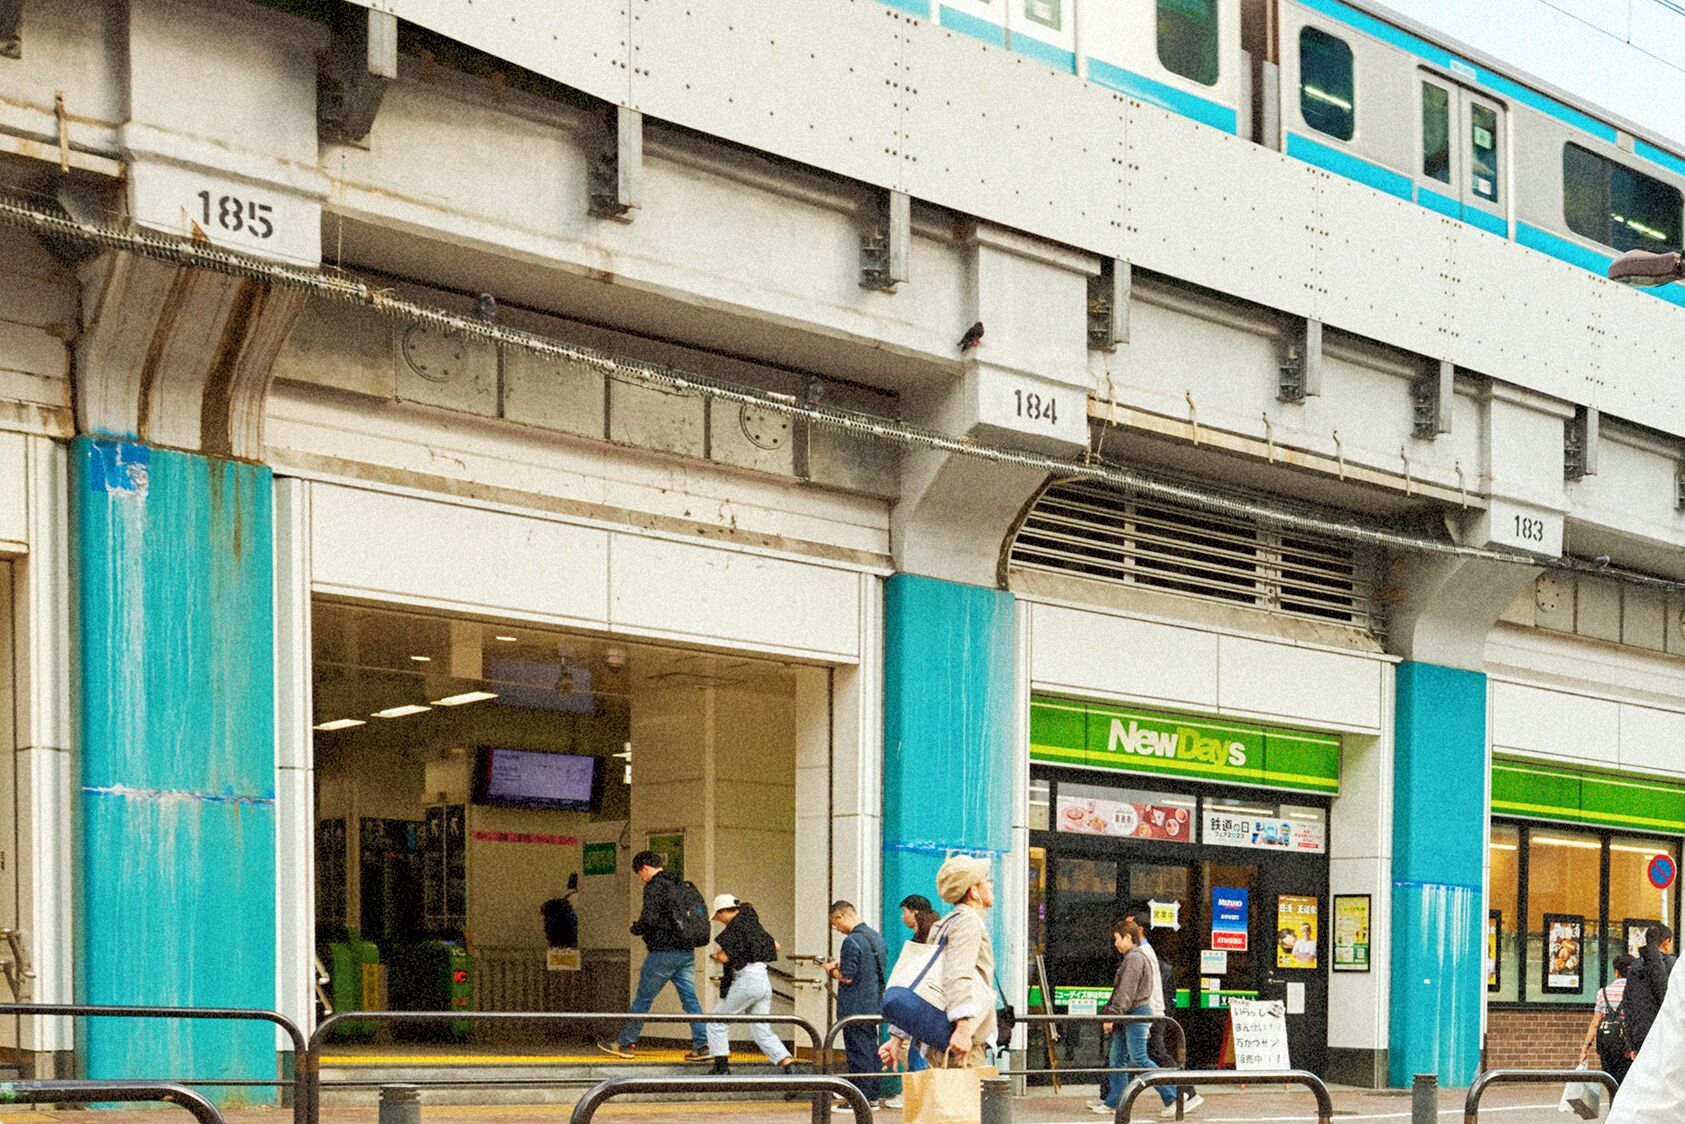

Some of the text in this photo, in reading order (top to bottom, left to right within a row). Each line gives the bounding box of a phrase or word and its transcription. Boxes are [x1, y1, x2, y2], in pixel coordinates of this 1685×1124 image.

[197, 190, 273, 239] 185
[1014, 388, 1058, 425] 184
[1514, 515, 1544, 542] 183
[1107, 718, 1247, 767] NewDays
[1210, 817, 1250, 833] 鉄道の日
[1218, 898, 1243, 908] MIZUHO
